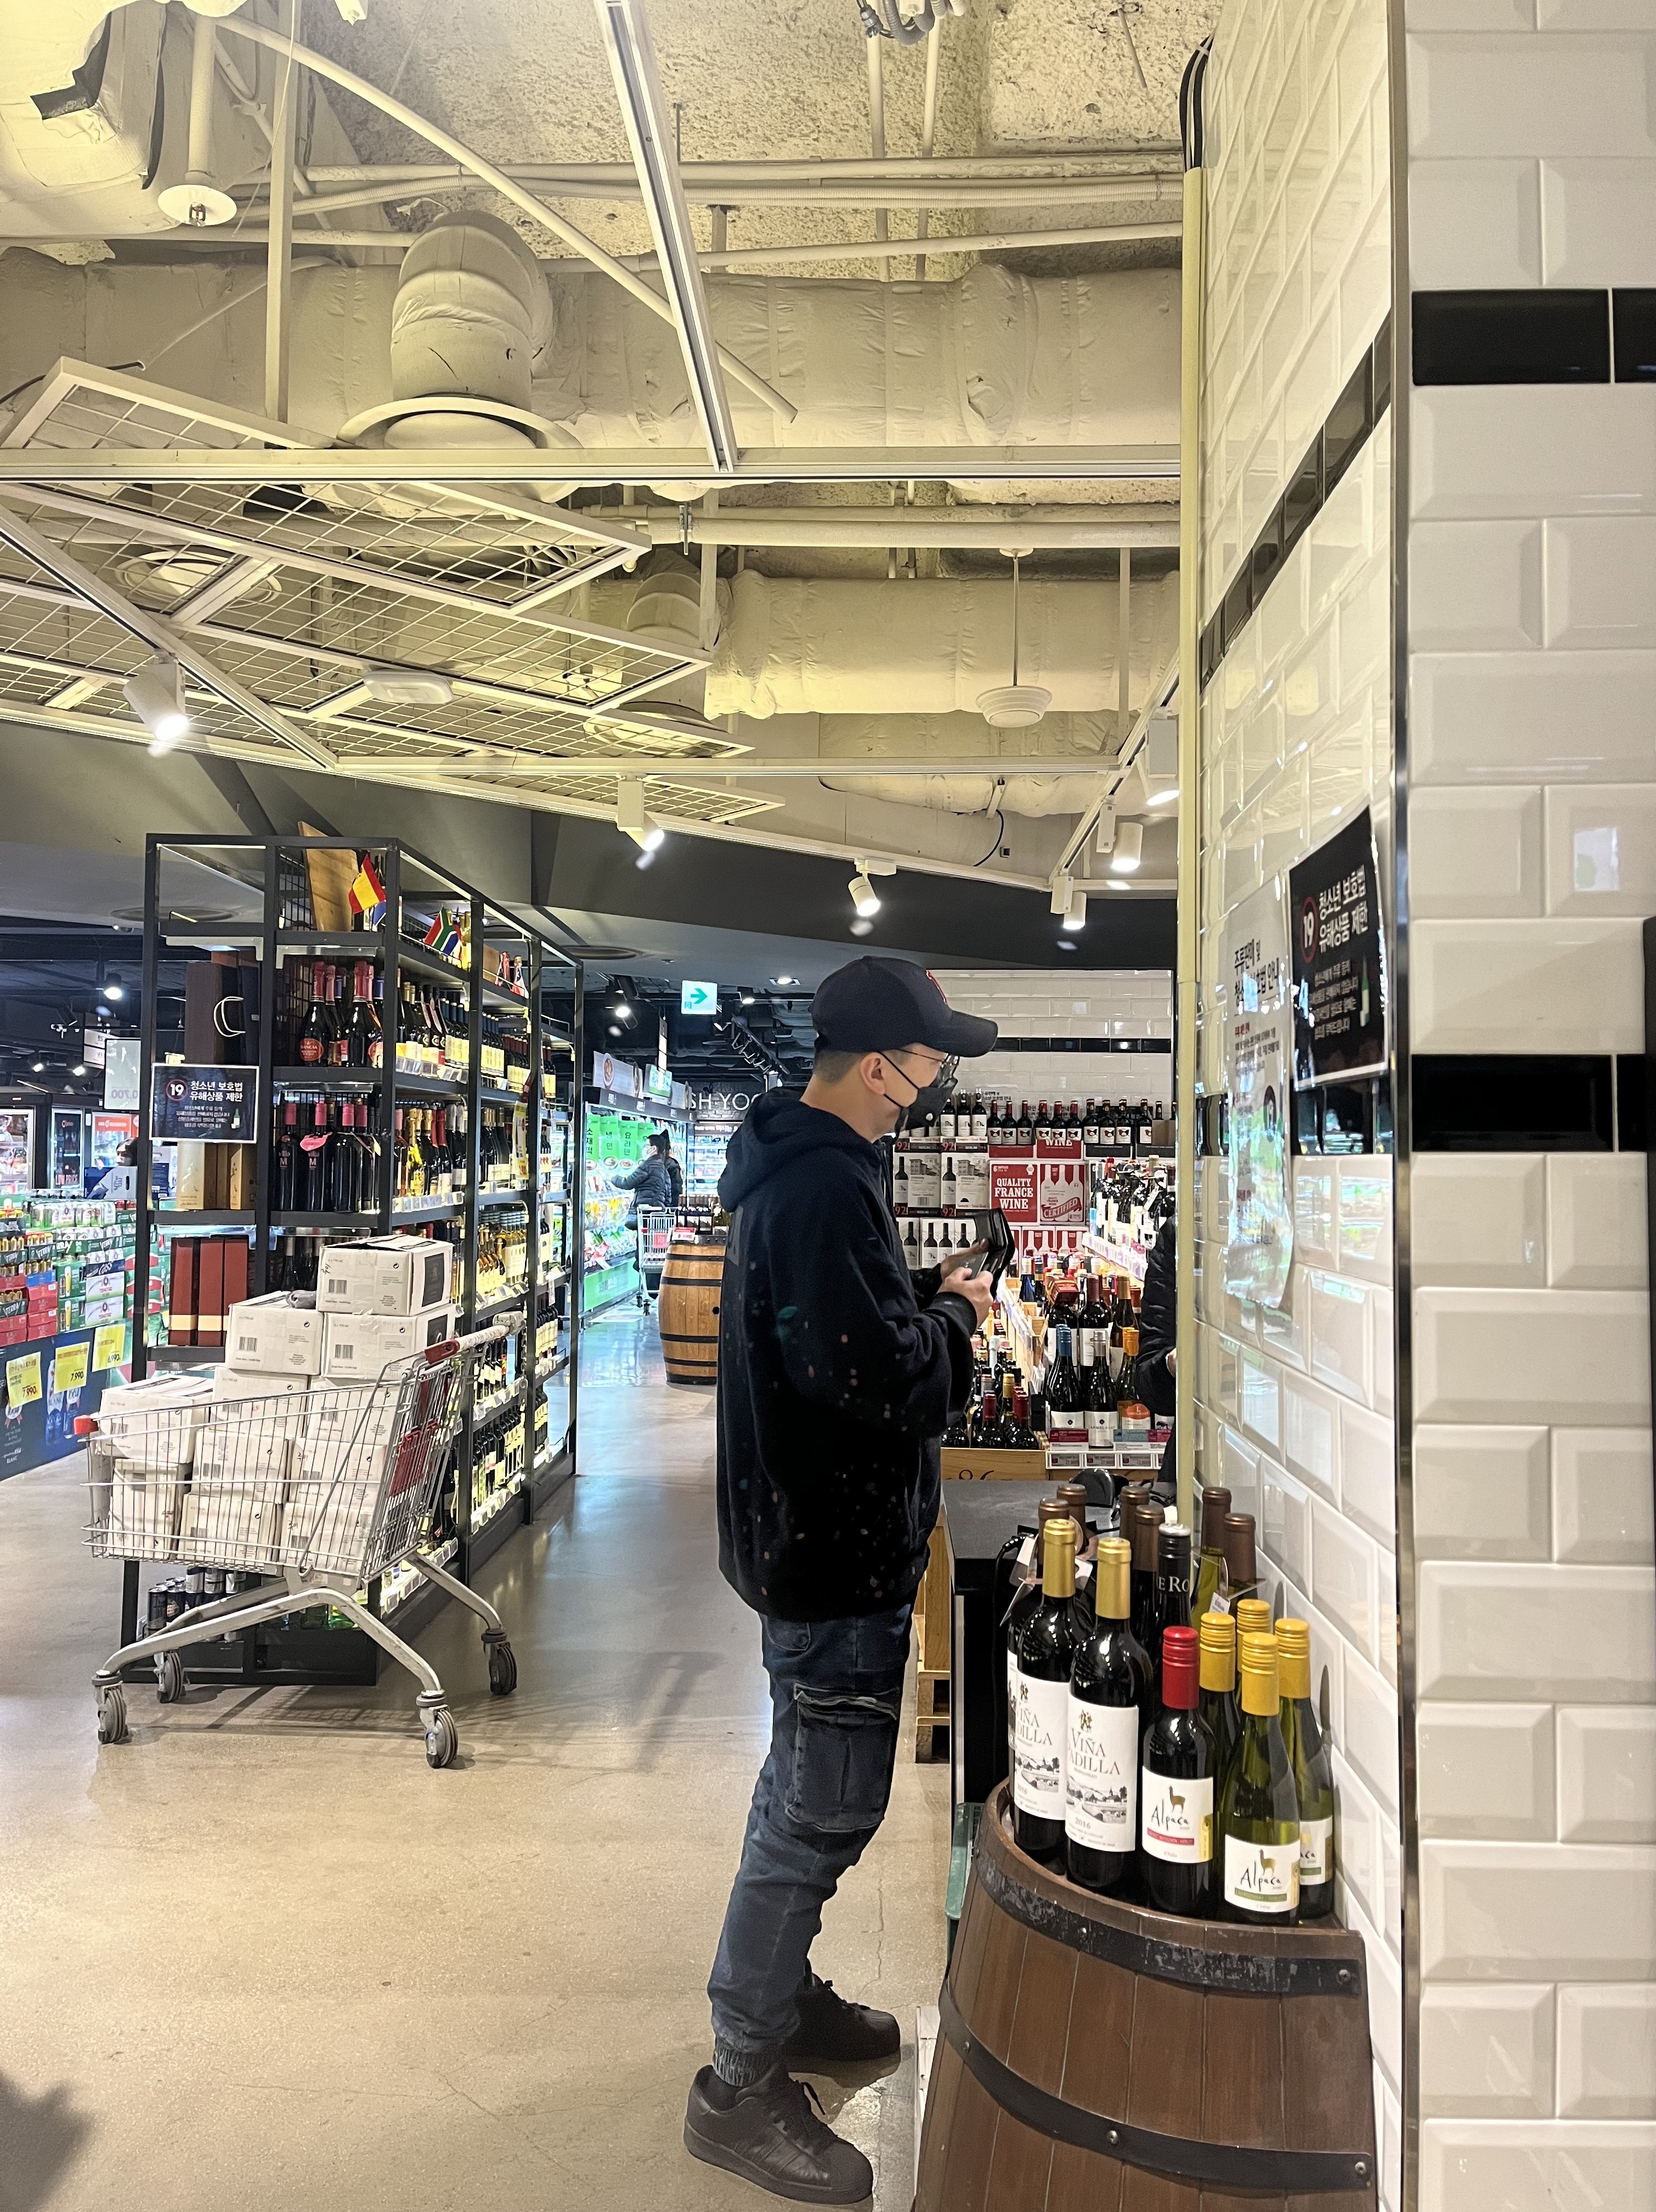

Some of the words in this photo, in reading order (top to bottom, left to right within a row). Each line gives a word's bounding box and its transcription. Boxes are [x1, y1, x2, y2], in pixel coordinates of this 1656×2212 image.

[1319, 881, 1341, 921] 청소년
[1343, 865, 1366, 905] 보호법
[1303, 912, 1314, 948] 19
[1319, 912, 1350, 953] 유해상품
[1352, 900, 1368, 934] 제한
[1235, 939, 1254, 976] 주류판매
[1268, 957, 1279, 990] 안내
[170, 1084, 184, 1096] 19
[191, 1081, 215, 1091] 청소년
[218, 1082, 243, 1092] 보호법
[190, 1091, 223, 1102] 유해상품
[225, 1092, 243, 1102] 제한
[897, 1141, 908, 1150] 92
[943, 1142, 954, 1151] 92
[997, 1178, 1031, 1187] QUALITY
[994, 1188, 1033, 1197] FRANCE
[999, 1199, 1028, 1209] WINE
[1044, 1198, 1078, 1217] CERTIFIED
[895, 1206, 907, 1215] 92
[942, 1207, 954, 1217] 92
[37, 1245, 51, 1258] TERRA
[4, 1302, 20, 1314] TERRA
[1017, 1721, 1053, 1746] DILLA
[1071, 1727, 1106, 1757] VIÑA
[1151, 1798, 1189, 1831] Alpaca
[1075, 1818, 1091, 1829] 2016
[1240, 1860, 1281, 1892] Alpaca
